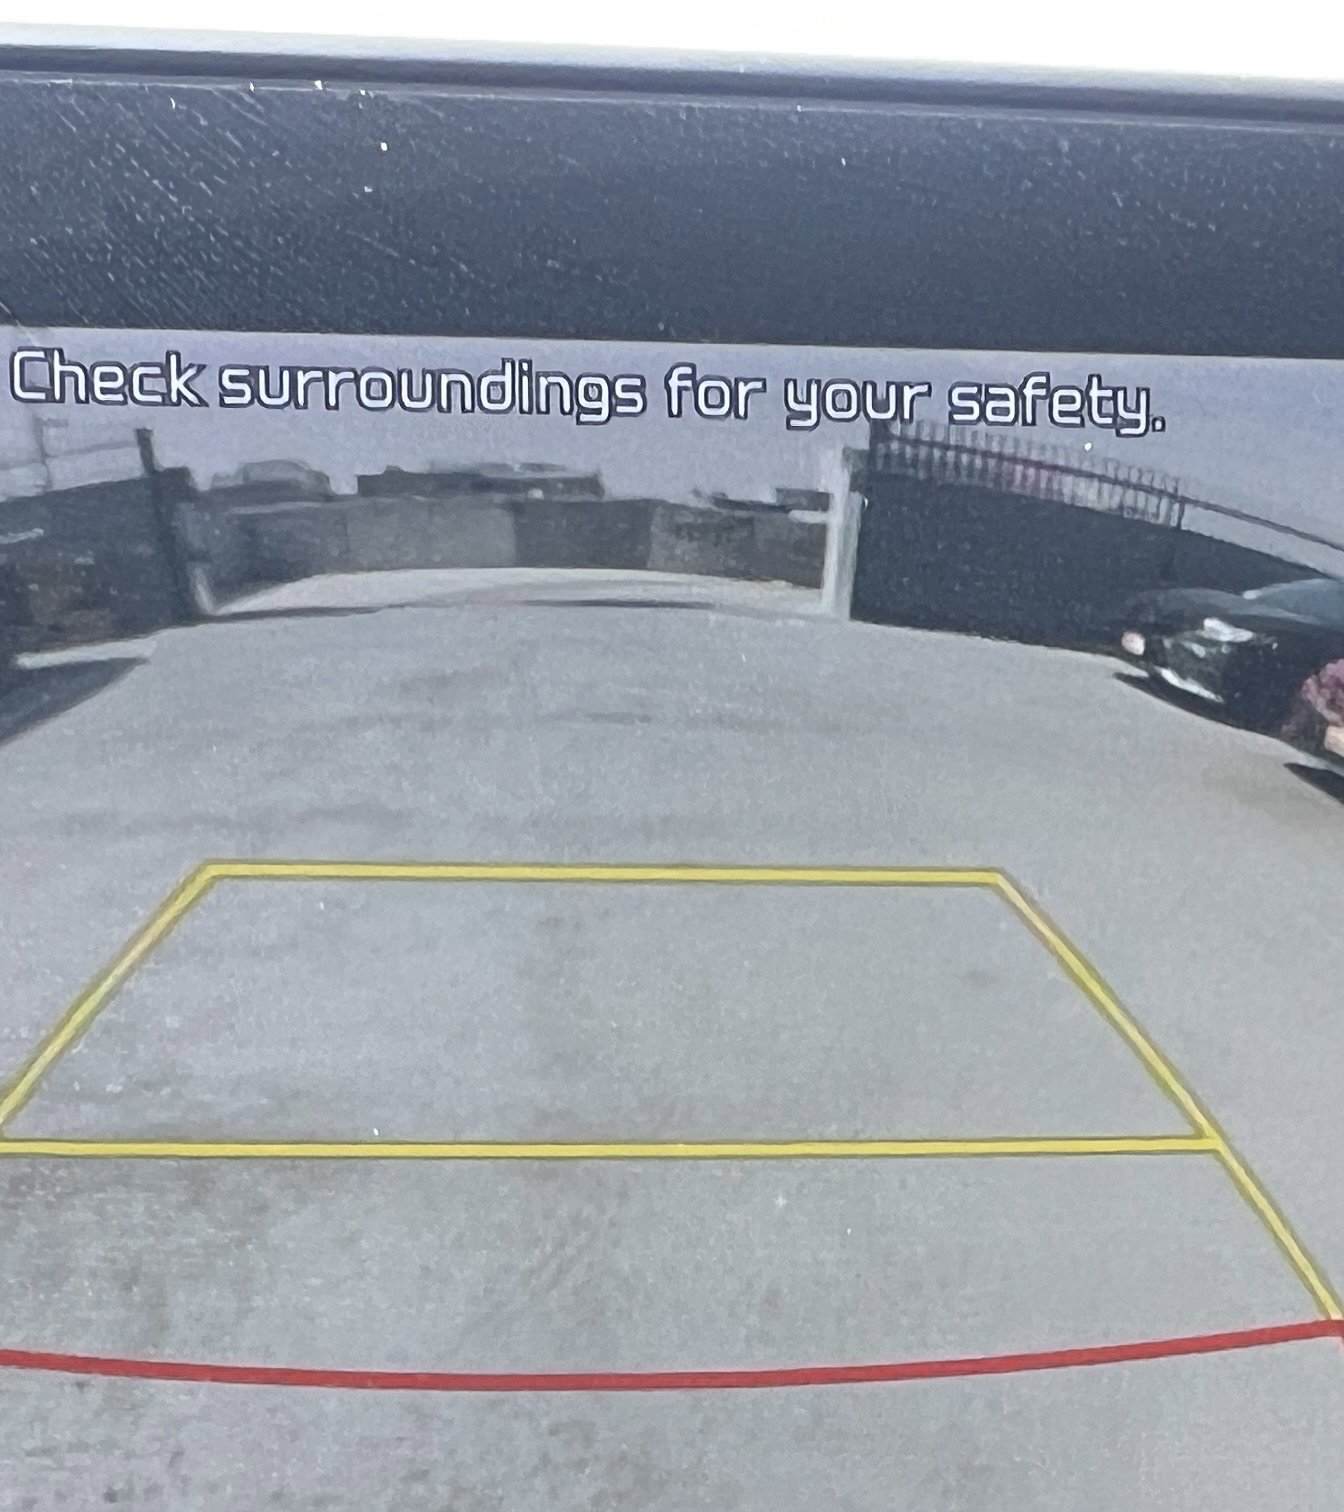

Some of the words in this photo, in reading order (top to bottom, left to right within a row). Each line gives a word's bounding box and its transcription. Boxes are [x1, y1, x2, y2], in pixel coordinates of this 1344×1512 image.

[11, 347, 207, 407] Check
[220, 358, 646, 424] surroundings
[666, 363, 766, 419] for
[785, 378, 931, 430] your
[948, 372, 1166, 438] safety.
